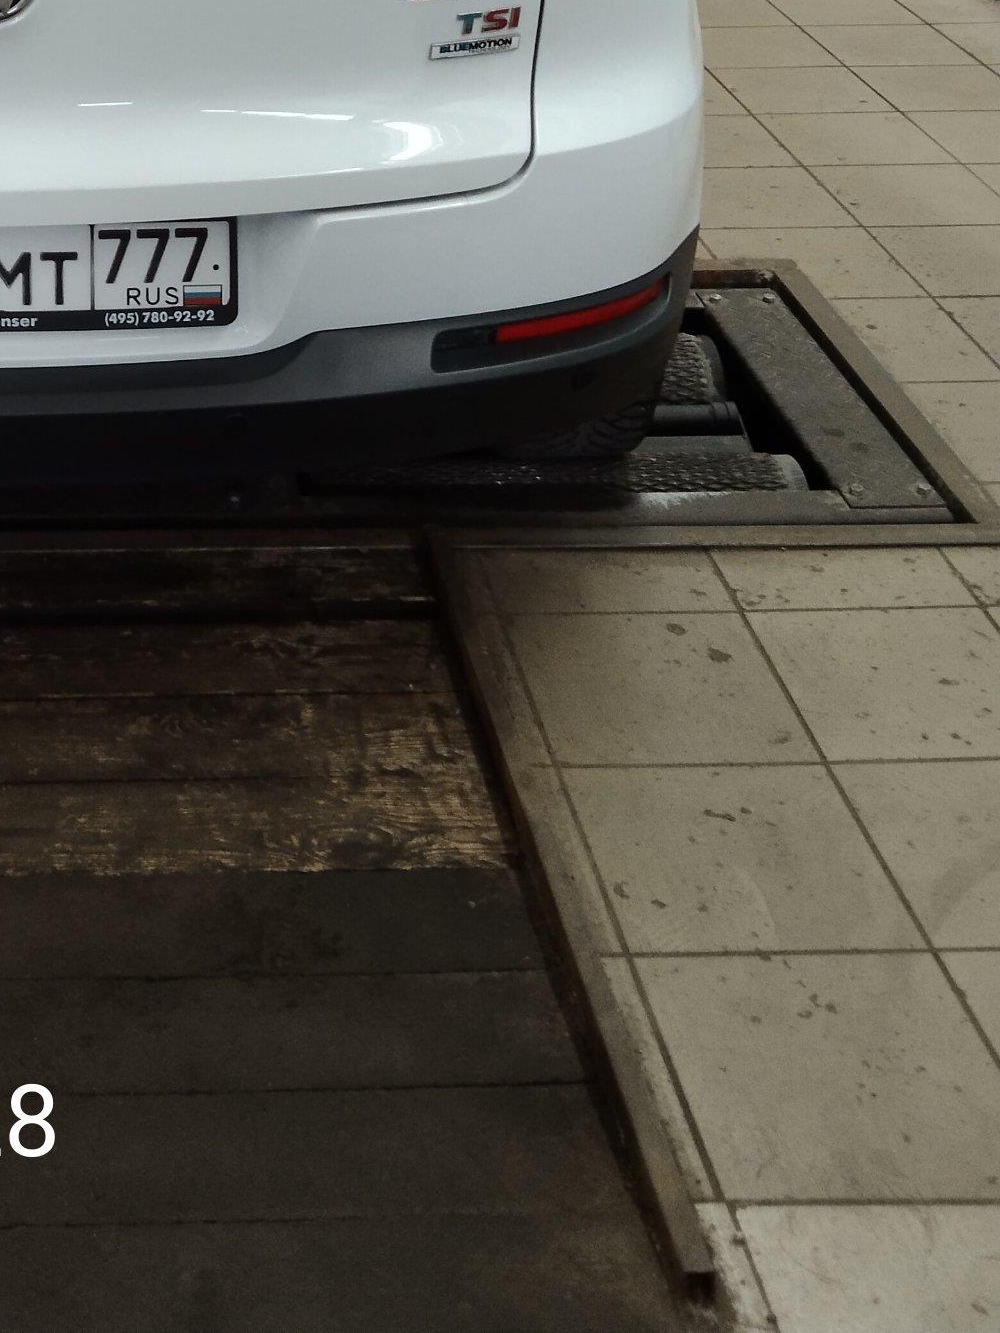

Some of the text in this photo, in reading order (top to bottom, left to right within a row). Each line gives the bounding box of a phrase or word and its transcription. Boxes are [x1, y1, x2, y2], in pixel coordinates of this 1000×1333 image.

[456, 6, 521, 35] TSI
[439, 37, 513, 54] BLUEMOTION
[97, 227, 208, 284] 777
[126, 286, 180, 306] RUS
[104, 311, 140, 328] (495)
[141, 309, 216, 324] 780-92-92
